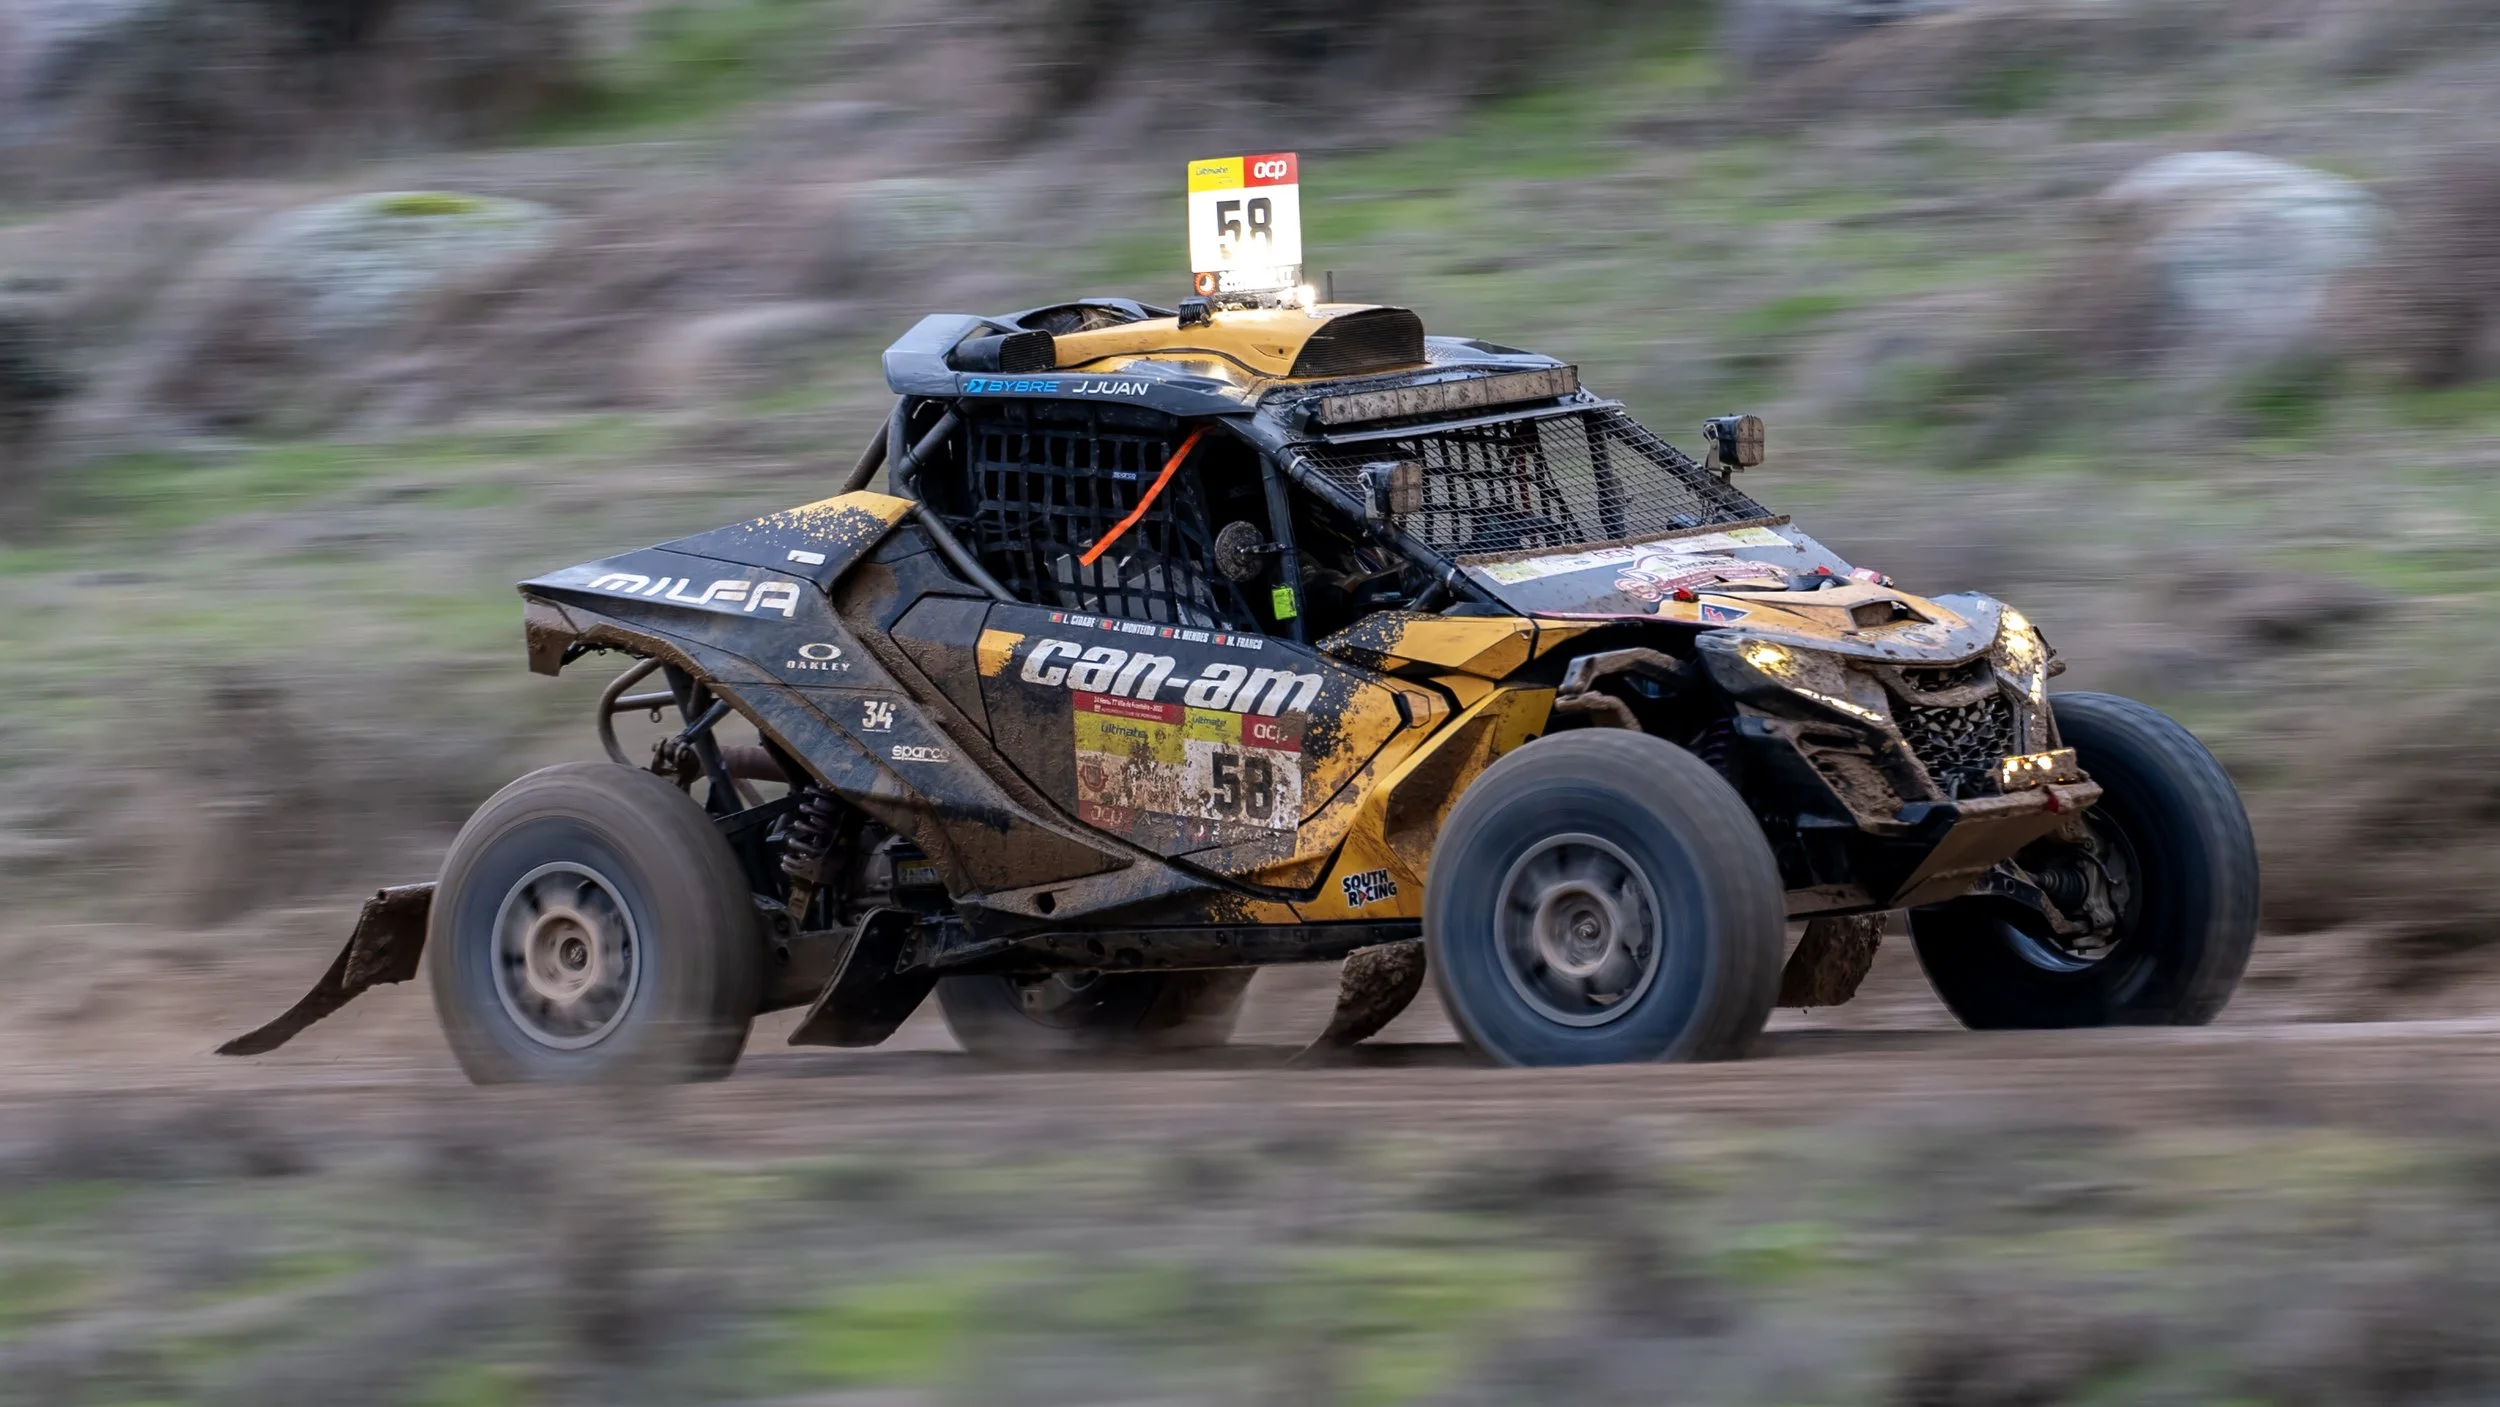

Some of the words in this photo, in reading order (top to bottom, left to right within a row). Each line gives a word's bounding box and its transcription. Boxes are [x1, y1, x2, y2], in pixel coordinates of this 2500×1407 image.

[1254, 160, 1288, 179] acp
[1216, 197, 1273, 261] 58
[987, 380, 1060, 392] BYBRE
[587, 573, 800, 618] MILFA
[1121, 622, 1156, 636] MONTEIRO
[1182, 630, 1209, 643] MENDES
[1236, 637, 1263, 650] FRANCO
[786, 660, 851, 672] OAKLEY
[1020, 638, 1324, 717] can-am
[1101, 722, 1148, 739] ultimate
[1192, 716, 1227, 726] ultimate
[891, 745, 950, 760] sparco
[1212, 752, 1273, 820] 58
[1342, 869, 1388, 893] SOUTH
